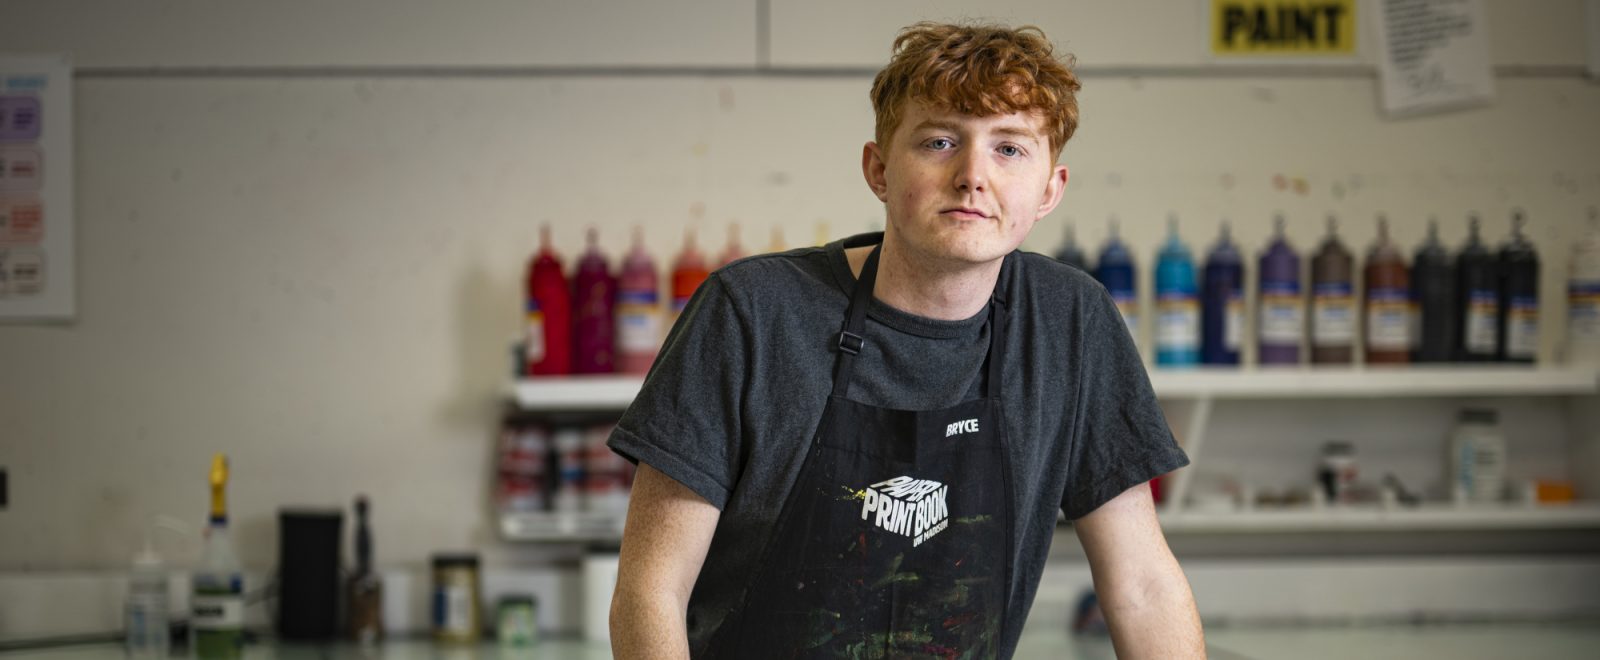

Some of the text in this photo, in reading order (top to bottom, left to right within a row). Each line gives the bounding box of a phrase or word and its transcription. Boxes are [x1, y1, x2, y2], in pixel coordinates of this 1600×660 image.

[1221, 4, 1346, 48] PAINT
[945, 418, 979, 438] BRYCE
[870, 475, 942, 502] PAPER
[861, 485, 948, 537] PRINT BOOK
